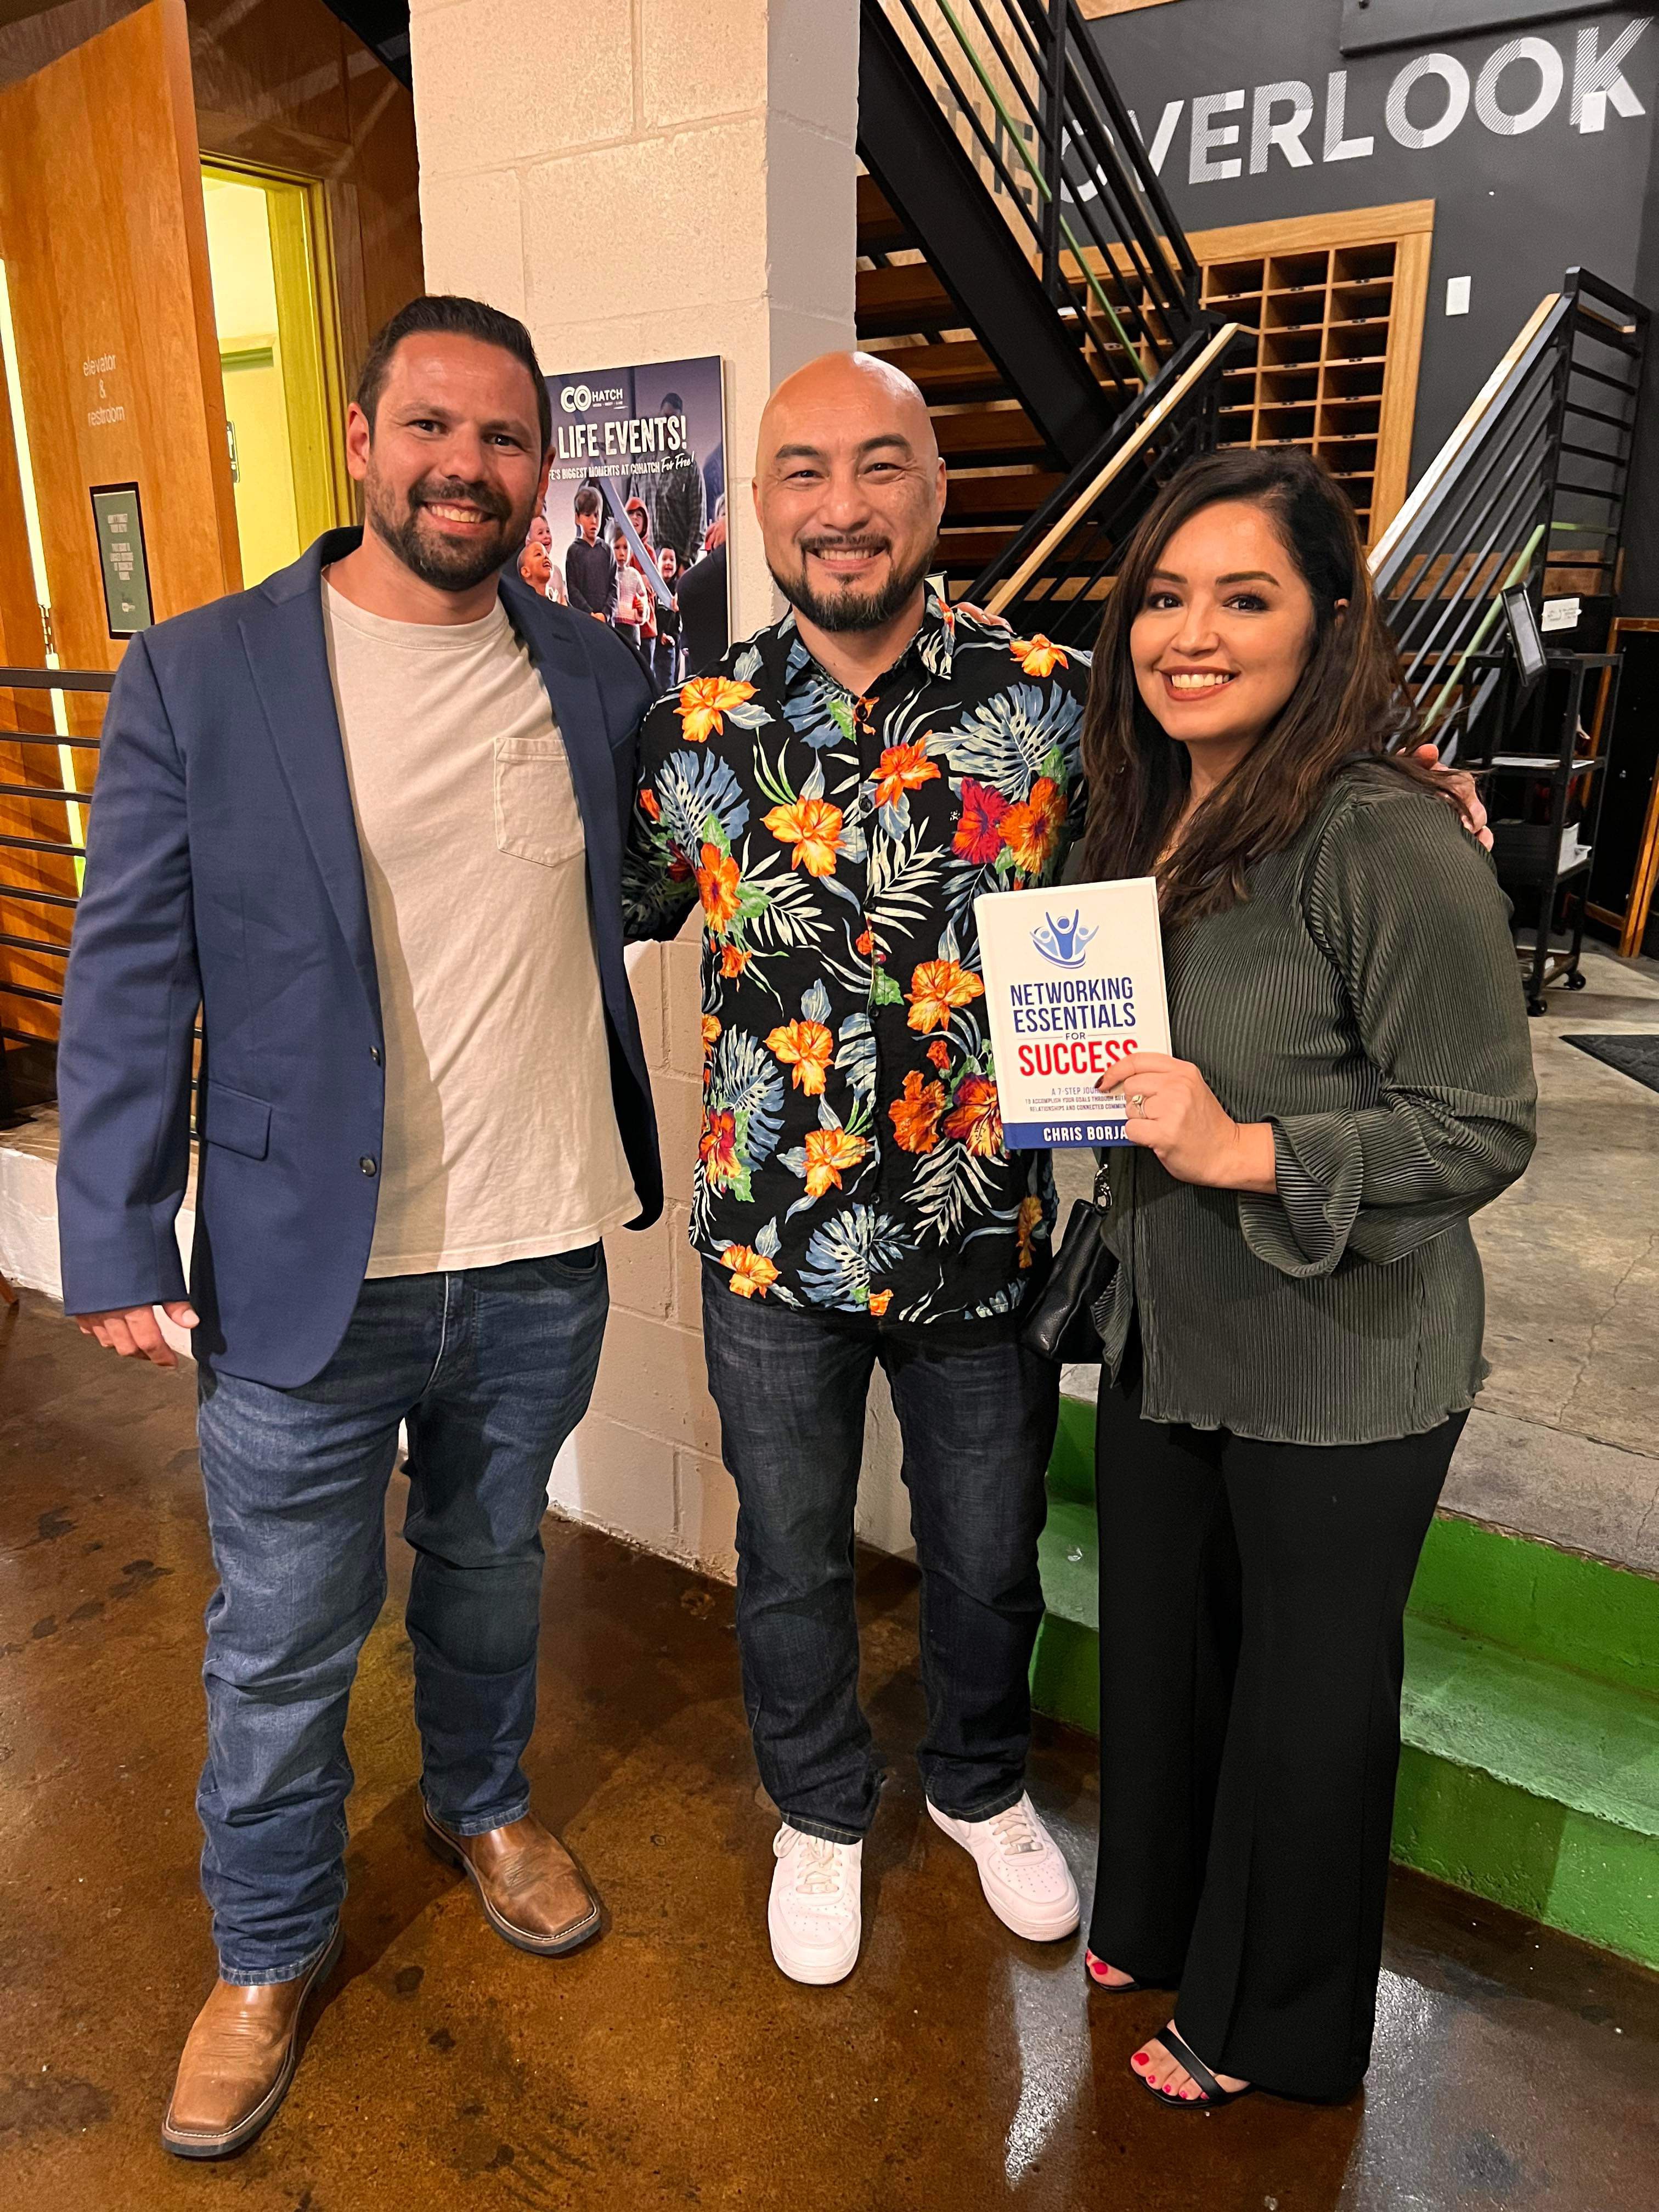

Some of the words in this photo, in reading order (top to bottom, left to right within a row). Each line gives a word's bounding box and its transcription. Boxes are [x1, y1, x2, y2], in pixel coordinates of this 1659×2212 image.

[83, 353, 116, 376] elevator
[99, 378, 106, 399] &
[87, 406, 125, 427] restroom
[557, 424, 600, 459] LIFE
[605, 415, 687, 455] EVENTS!
[561, 467, 588, 479] BIGGEST
[588, 465, 620, 478] MOMENTS
[620, 464, 630, 476] AT
[630, 461, 661, 475] COHATCH
[661, 456, 675, 473] For
[1010, 977, 1133, 1006] NETWORKING
[1013, 1002, 1136, 1033] ESSENTIALS
[1065, 1032, 1086, 1041] FOR
[1043, 1127, 1083, 1142] CHRIS
[1087, 1125, 1128, 1141] BORJA
